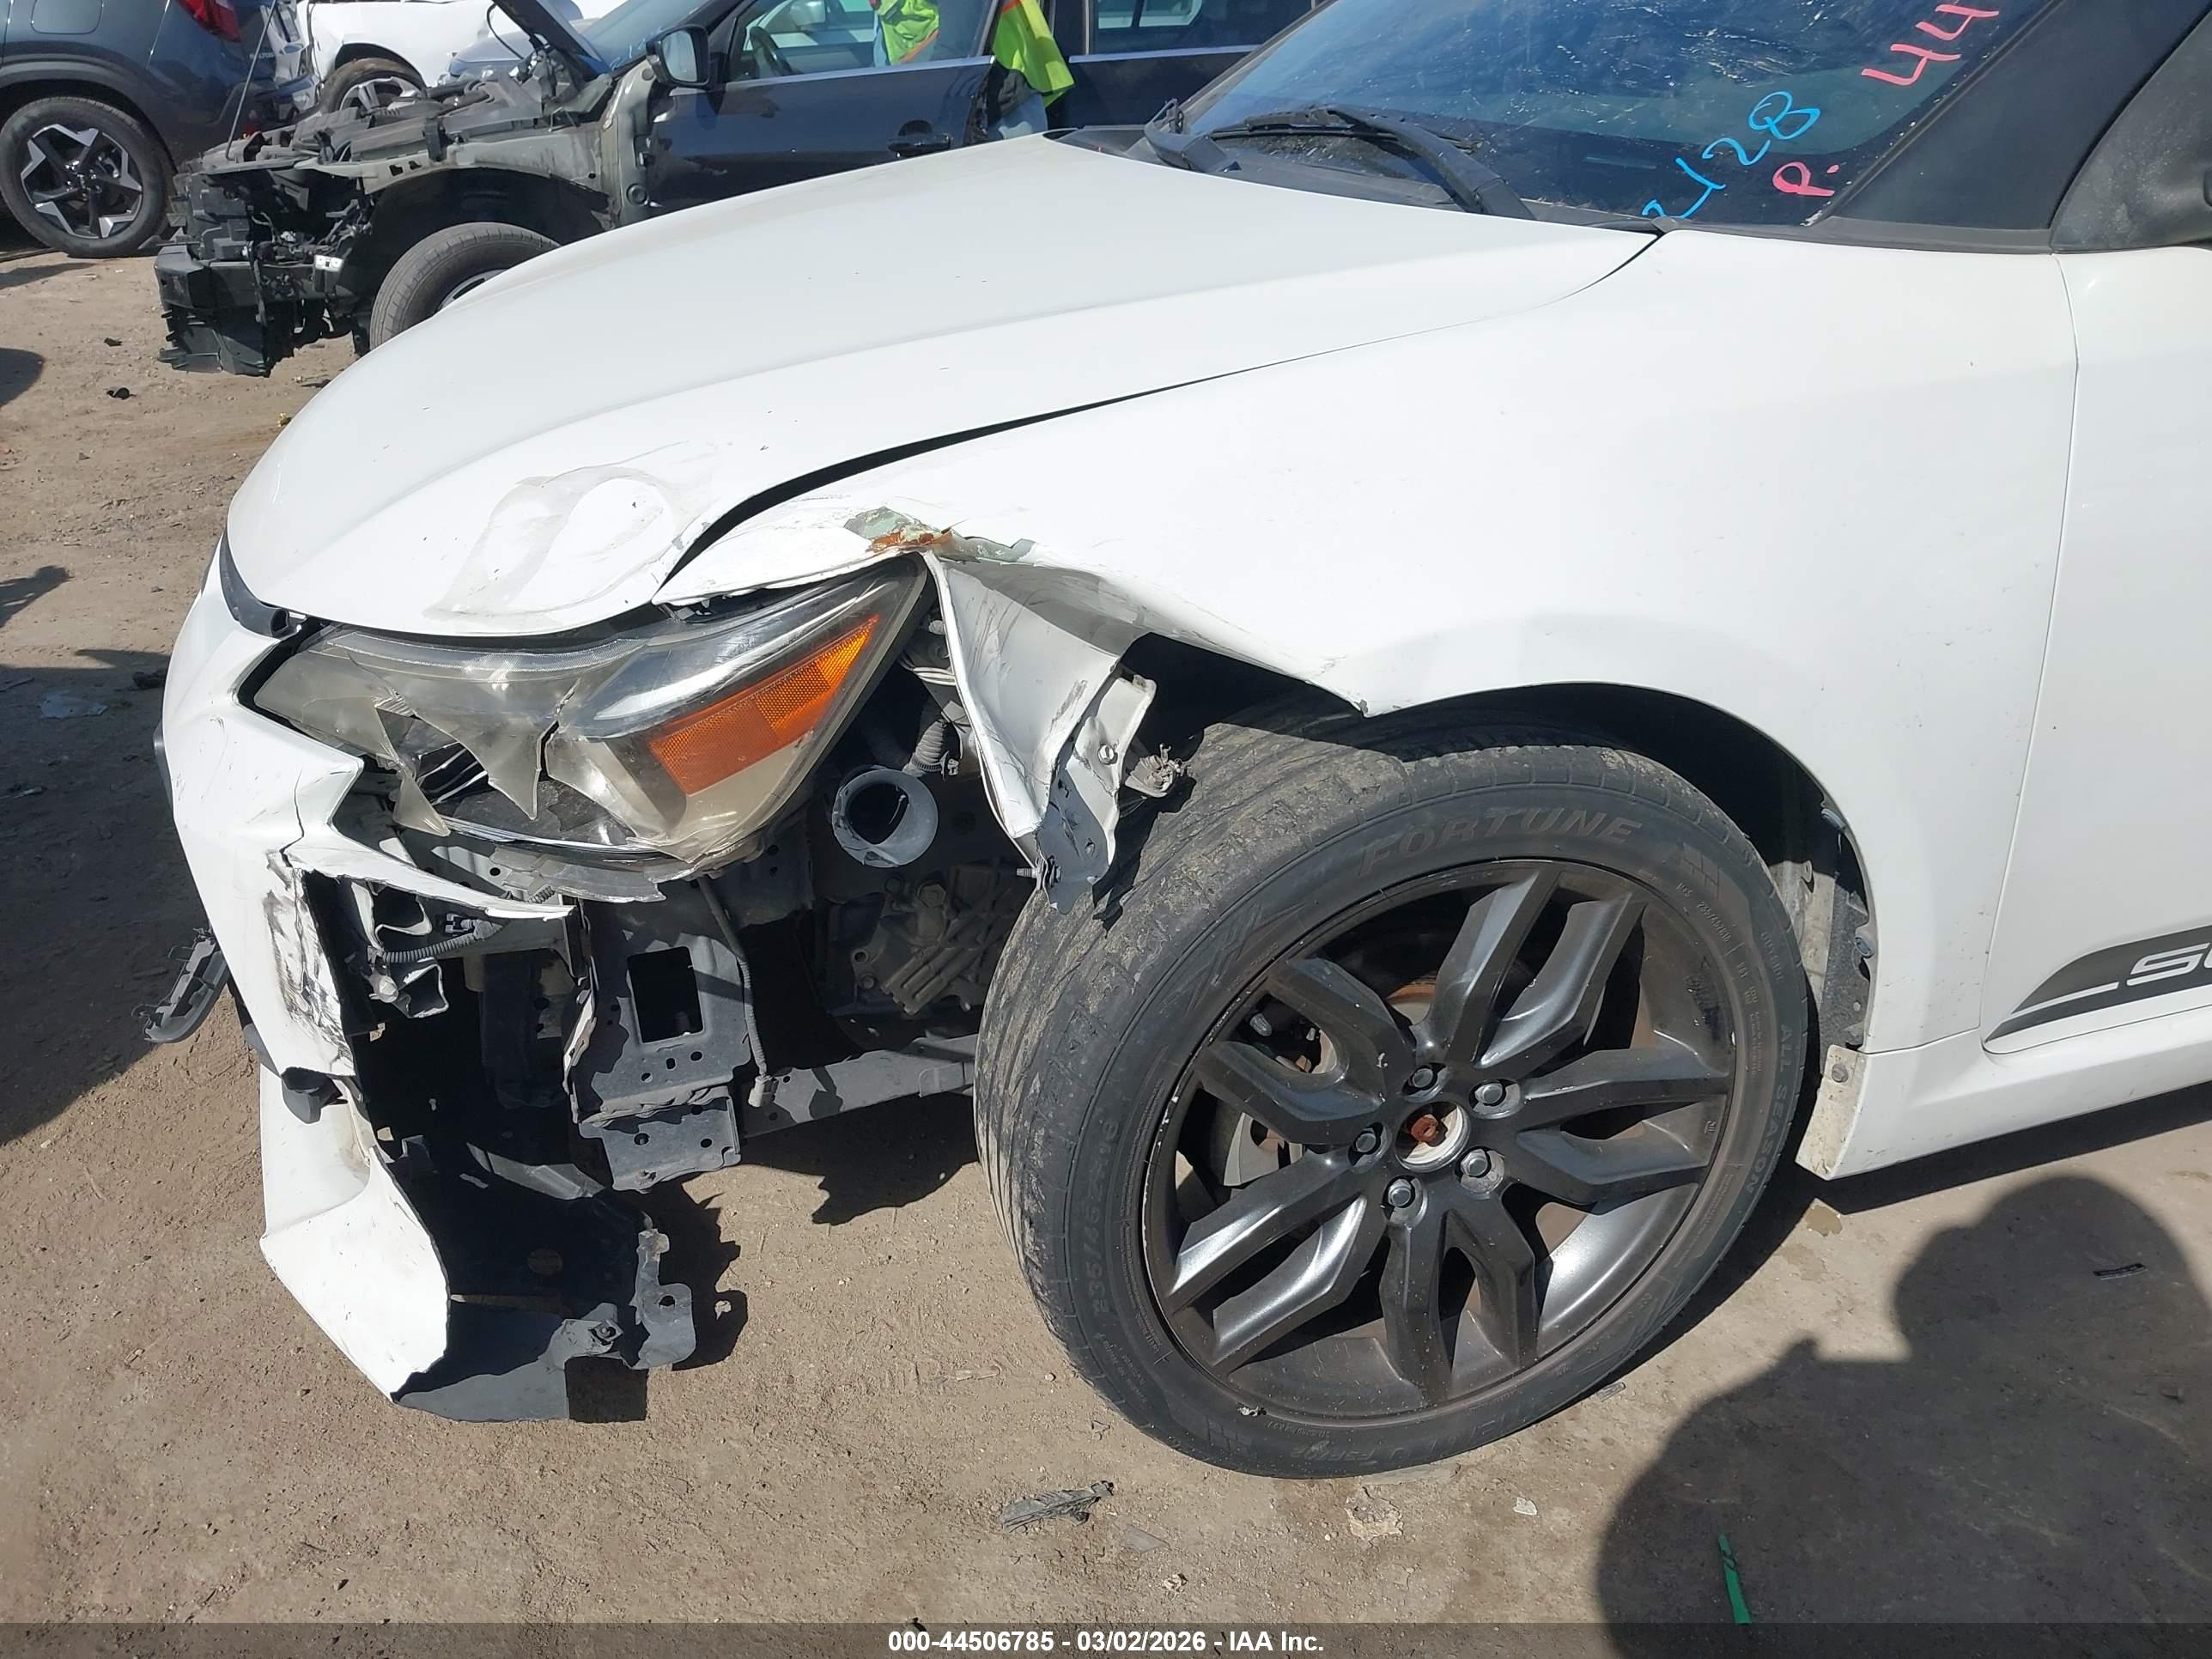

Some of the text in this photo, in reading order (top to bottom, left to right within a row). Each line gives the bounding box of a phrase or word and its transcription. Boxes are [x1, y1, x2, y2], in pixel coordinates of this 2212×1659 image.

[1861, 3, 2000, 85] 44
[1356, 806, 1643, 878] FORTUNE
[1778, 1022, 1795, 1075] ALL
[1744, 1084, 1792, 1194] SEASON
